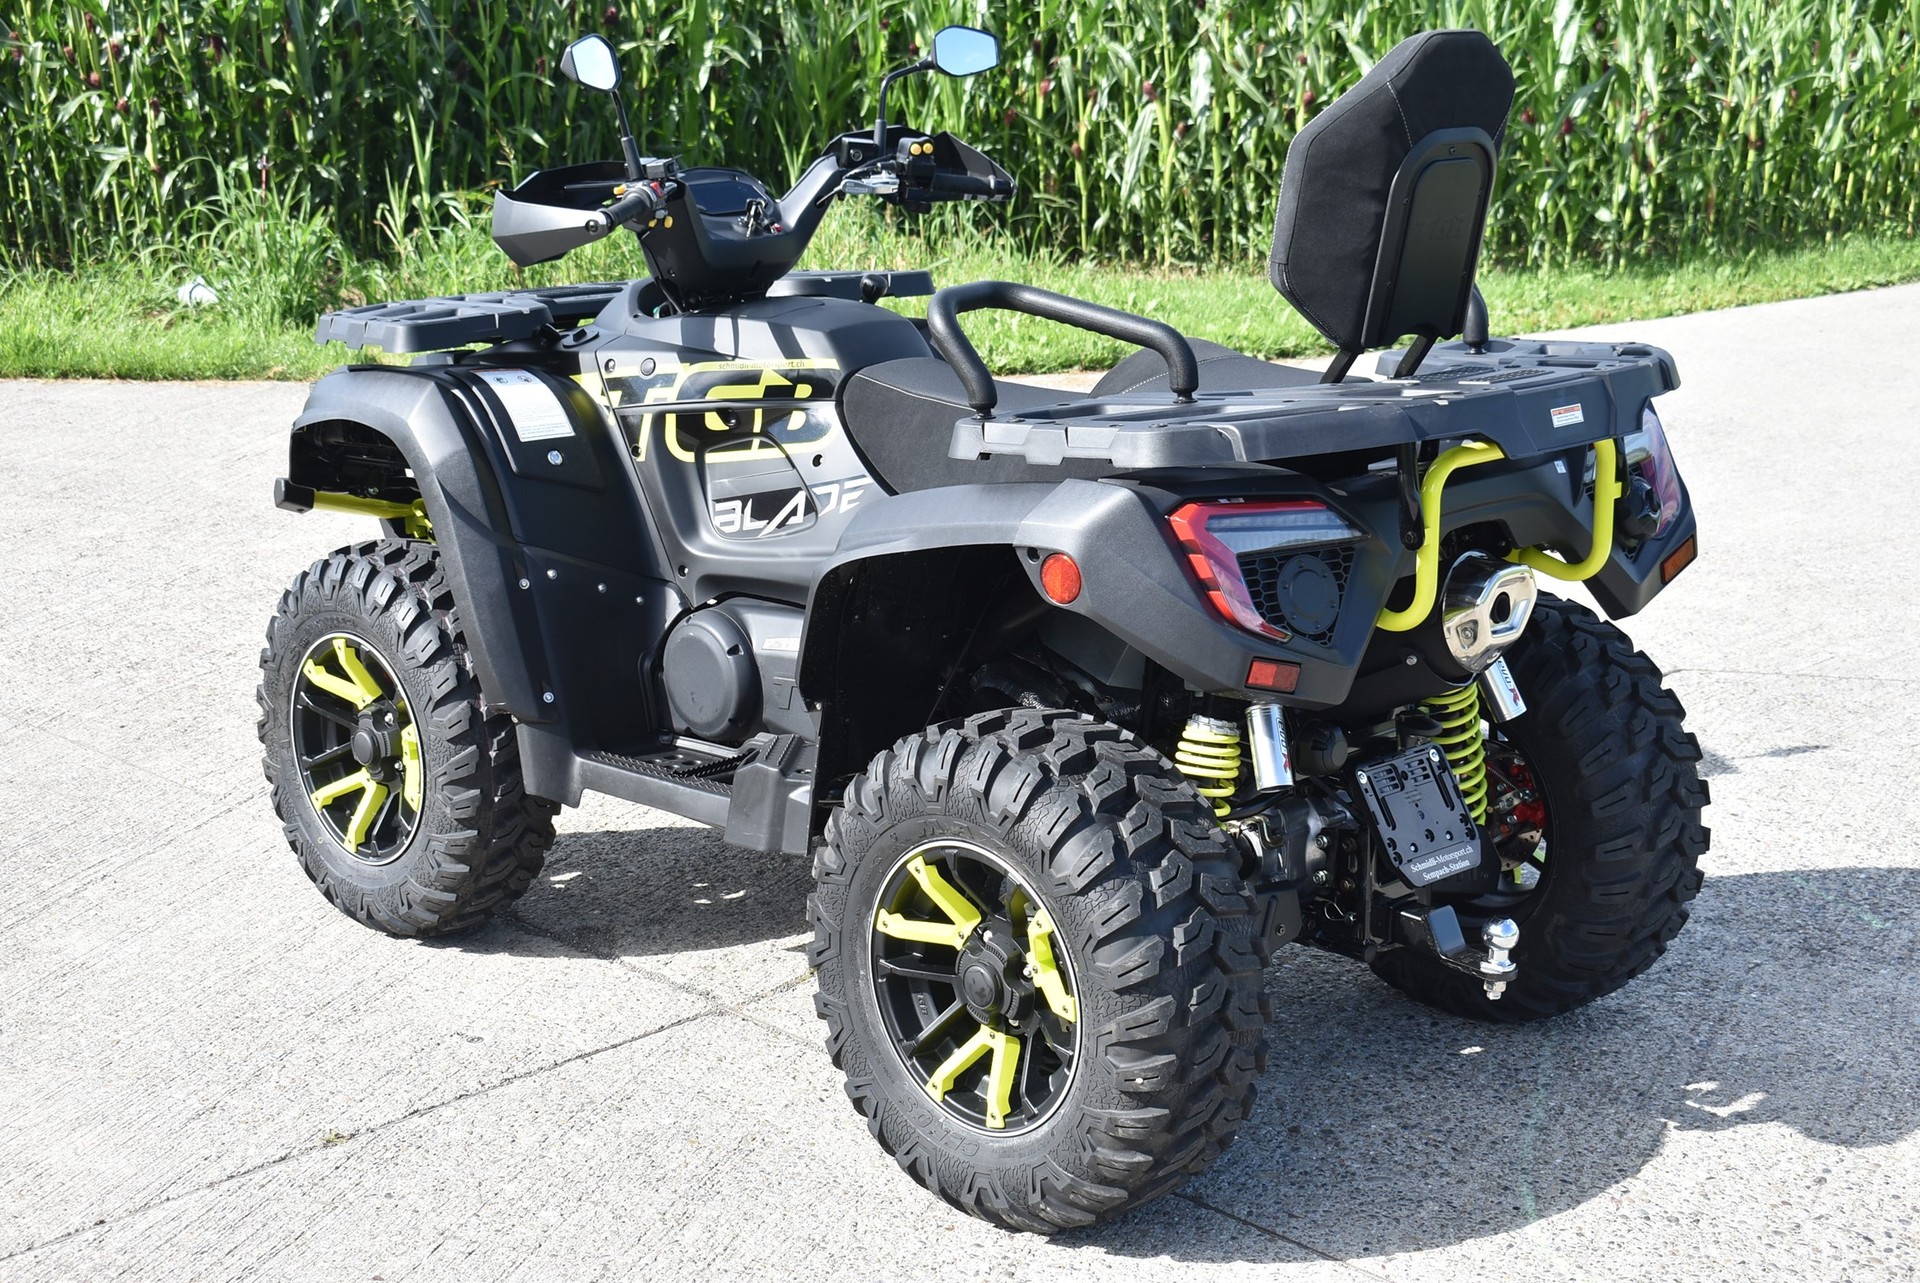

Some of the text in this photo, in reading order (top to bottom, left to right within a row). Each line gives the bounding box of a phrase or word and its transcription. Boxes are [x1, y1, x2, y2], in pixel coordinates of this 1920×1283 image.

[713, 477, 875, 538] BLADE
[1409, 845, 1474, 873] Schmidli-Motorsport.ch
[1422, 859, 1471, 881] Sempach-Station
